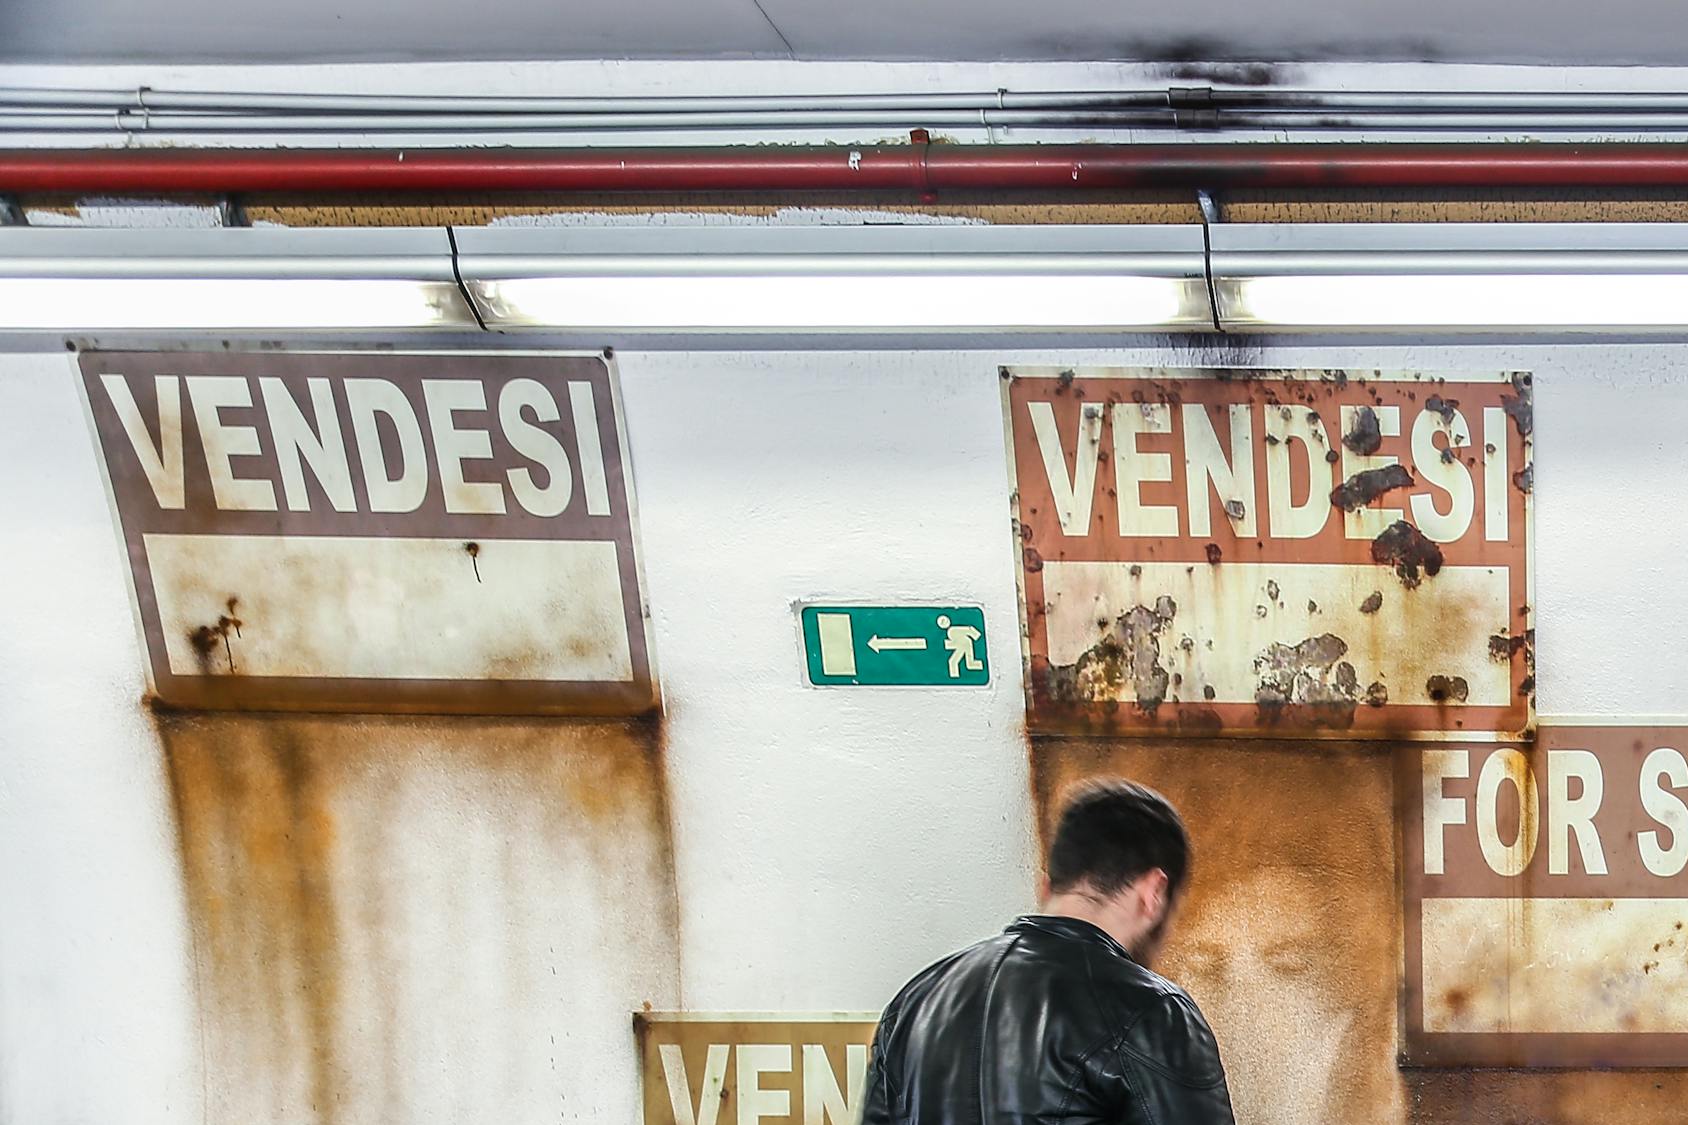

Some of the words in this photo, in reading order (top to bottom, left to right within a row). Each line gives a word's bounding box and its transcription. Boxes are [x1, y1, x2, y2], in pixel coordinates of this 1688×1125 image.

[100, 375, 612, 516] VENDESI
[1027, 402, 1508, 542] VENDESI
[1421, 748, 1608, 876] FOR
